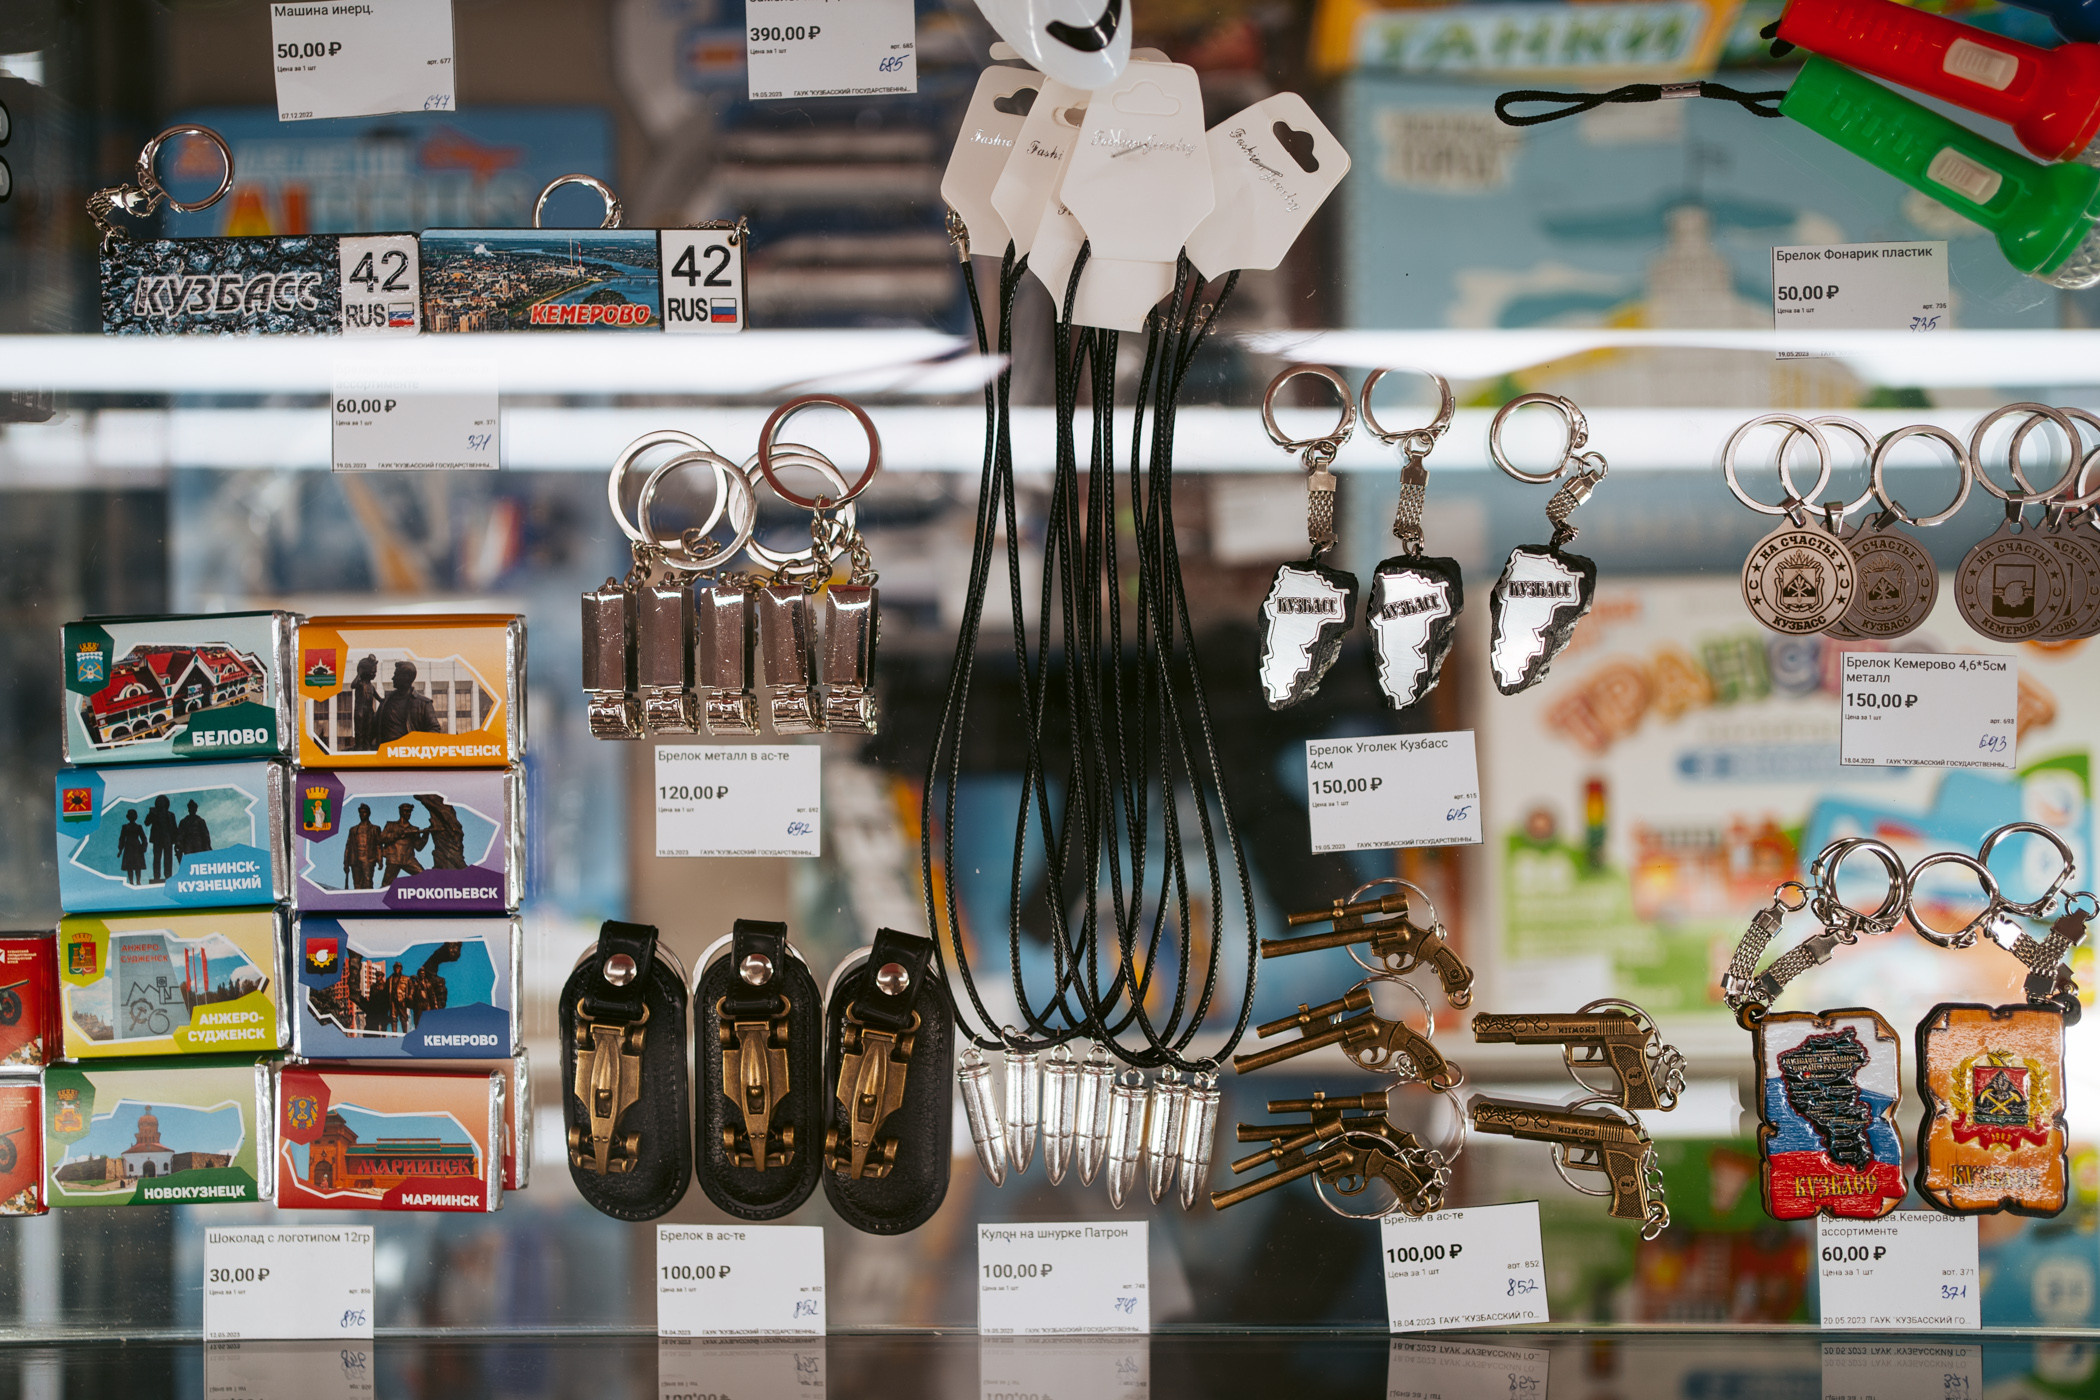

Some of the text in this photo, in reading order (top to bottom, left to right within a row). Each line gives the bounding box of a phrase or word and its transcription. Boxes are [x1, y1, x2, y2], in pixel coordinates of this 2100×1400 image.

[274, 5, 374, 16] Машина инерц.
[750, 26, 805, 42] 390,00
[277, 42, 325, 59] 50,00
[879, 54, 909, 72] 685
[424, 94, 450, 110] 677
[1777, 247, 1932, 263] Брелок Фонарик пластик
[350, 250, 410, 293] 42
[671, 244, 732, 287] 42
[134, 272, 322, 319] КУЗБАСС
[1778, 285, 1823, 301] 50,00
[346, 303, 386, 328] RUS
[529, 303, 651, 325] КЕМЕРОВО
[668, 298, 708, 323] RUS
[1910, 315, 1941, 332] 735
[337, 399, 381, 413] 60,00
[467, 433, 491, 451] 371
[1760, 535, 1837, 561] НА СЧАСТЬЕ
[1862, 539, 1916, 560] СЧАСТЬЕ
[1977, 543, 2053, 566] НА СЧАСТЬЕ
[2053, 541, 2090, 565] АСТЬЕ
[1509, 580, 1572, 598] КУЗБАСС
[1277, 597, 1338, 615] КУЗБАСС
[1381, 596, 1442, 620] КУЗБАСС
[1772, 615, 1827, 631] КУЗБАСС
[1861, 615, 1912, 631] КУЗБАСС
[1981, 617, 2041, 634] КЕМЕРОВО
[1847, 657, 1890, 669] Брелок
[1894, 658, 1955, 672] Кемерово
[1846, 674, 1890, 682] металл
[1847, 693, 1901, 709] 150,00
[192, 728, 268, 747] БЕЛОВО
[1978, 734, 2007, 752] 693
[387, 744, 501, 759] МЕЖДУРЕЧЕНСК
[1309, 739, 1448, 756] Брелок Уголек Кузбасс
[658, 751, 789, 763] Брелок металл в ас-те
[1310, 760, 1333, 770] 4см
[659, 786, 713, 801] 120,00
[1312, 778, 1367, 794] 150,00
[1446, 805, 1471, 821] 615
[787, 822, 813, 836] 692
[189, 860, 260, 875] ЛЕНИНСК-
[177, 875, 262, 893] КУЗНЕЦКИЙ
[397, 887, 498, 901] ПРОКОПЬЕВСК
[120, 954, 169, 963] СУДЖЕНСК
[199, 1012, 264, 1026] АНЖЕРО-
[188, 1028, 265, 1042] СУДЖЕНСК
[423, 1034, 498, 1047] КЕМЕРОВО
[358, 1159, 471, 1175] МАРИИНСК
[1951, 1164, 2043, 1188] КУЗБАСС
[144, 1184, 246, 1200] НОВОКУЗНЕЦК
[1794, 1174, 1878, 1203] КУЗБАСС
[402, 1193, 479, 1207] МАРИИНСК
[1437, 1212, 1463, 1221] ас-те
[209, 1232, 370, 1245] Шоколад с логотипом 12гр
[661, 1231, 745, 1242] Брелок в ас-те
[982, 1228, 1128, 1241] Кулон на шнурке Патрон
[1822, 1229, 1898, 1238] ассортименте
[1387, 1244, 1462, 1263] 100,00 ₽
[1822, 1246, 1886, 1262] 60,00 ₽
[983, 1264, 1037, 1279] 100,00
[1524, 1260, 1539, 1268] 852
[210, 1268, 254, 1283] 30,00
[662, 1266, 715, 1280] 100,00
[1388, 1271, 1408, 1279] Цена
[1822, 1269, 1842, 1277] Цена
[1507, 1278, 1538, 1296] 852
[1941, 1285, 1966, 1299] 371
[341, 1309, 365, 1328] 856
[1393, 1318, 1435, 1327] 18.04.2023
